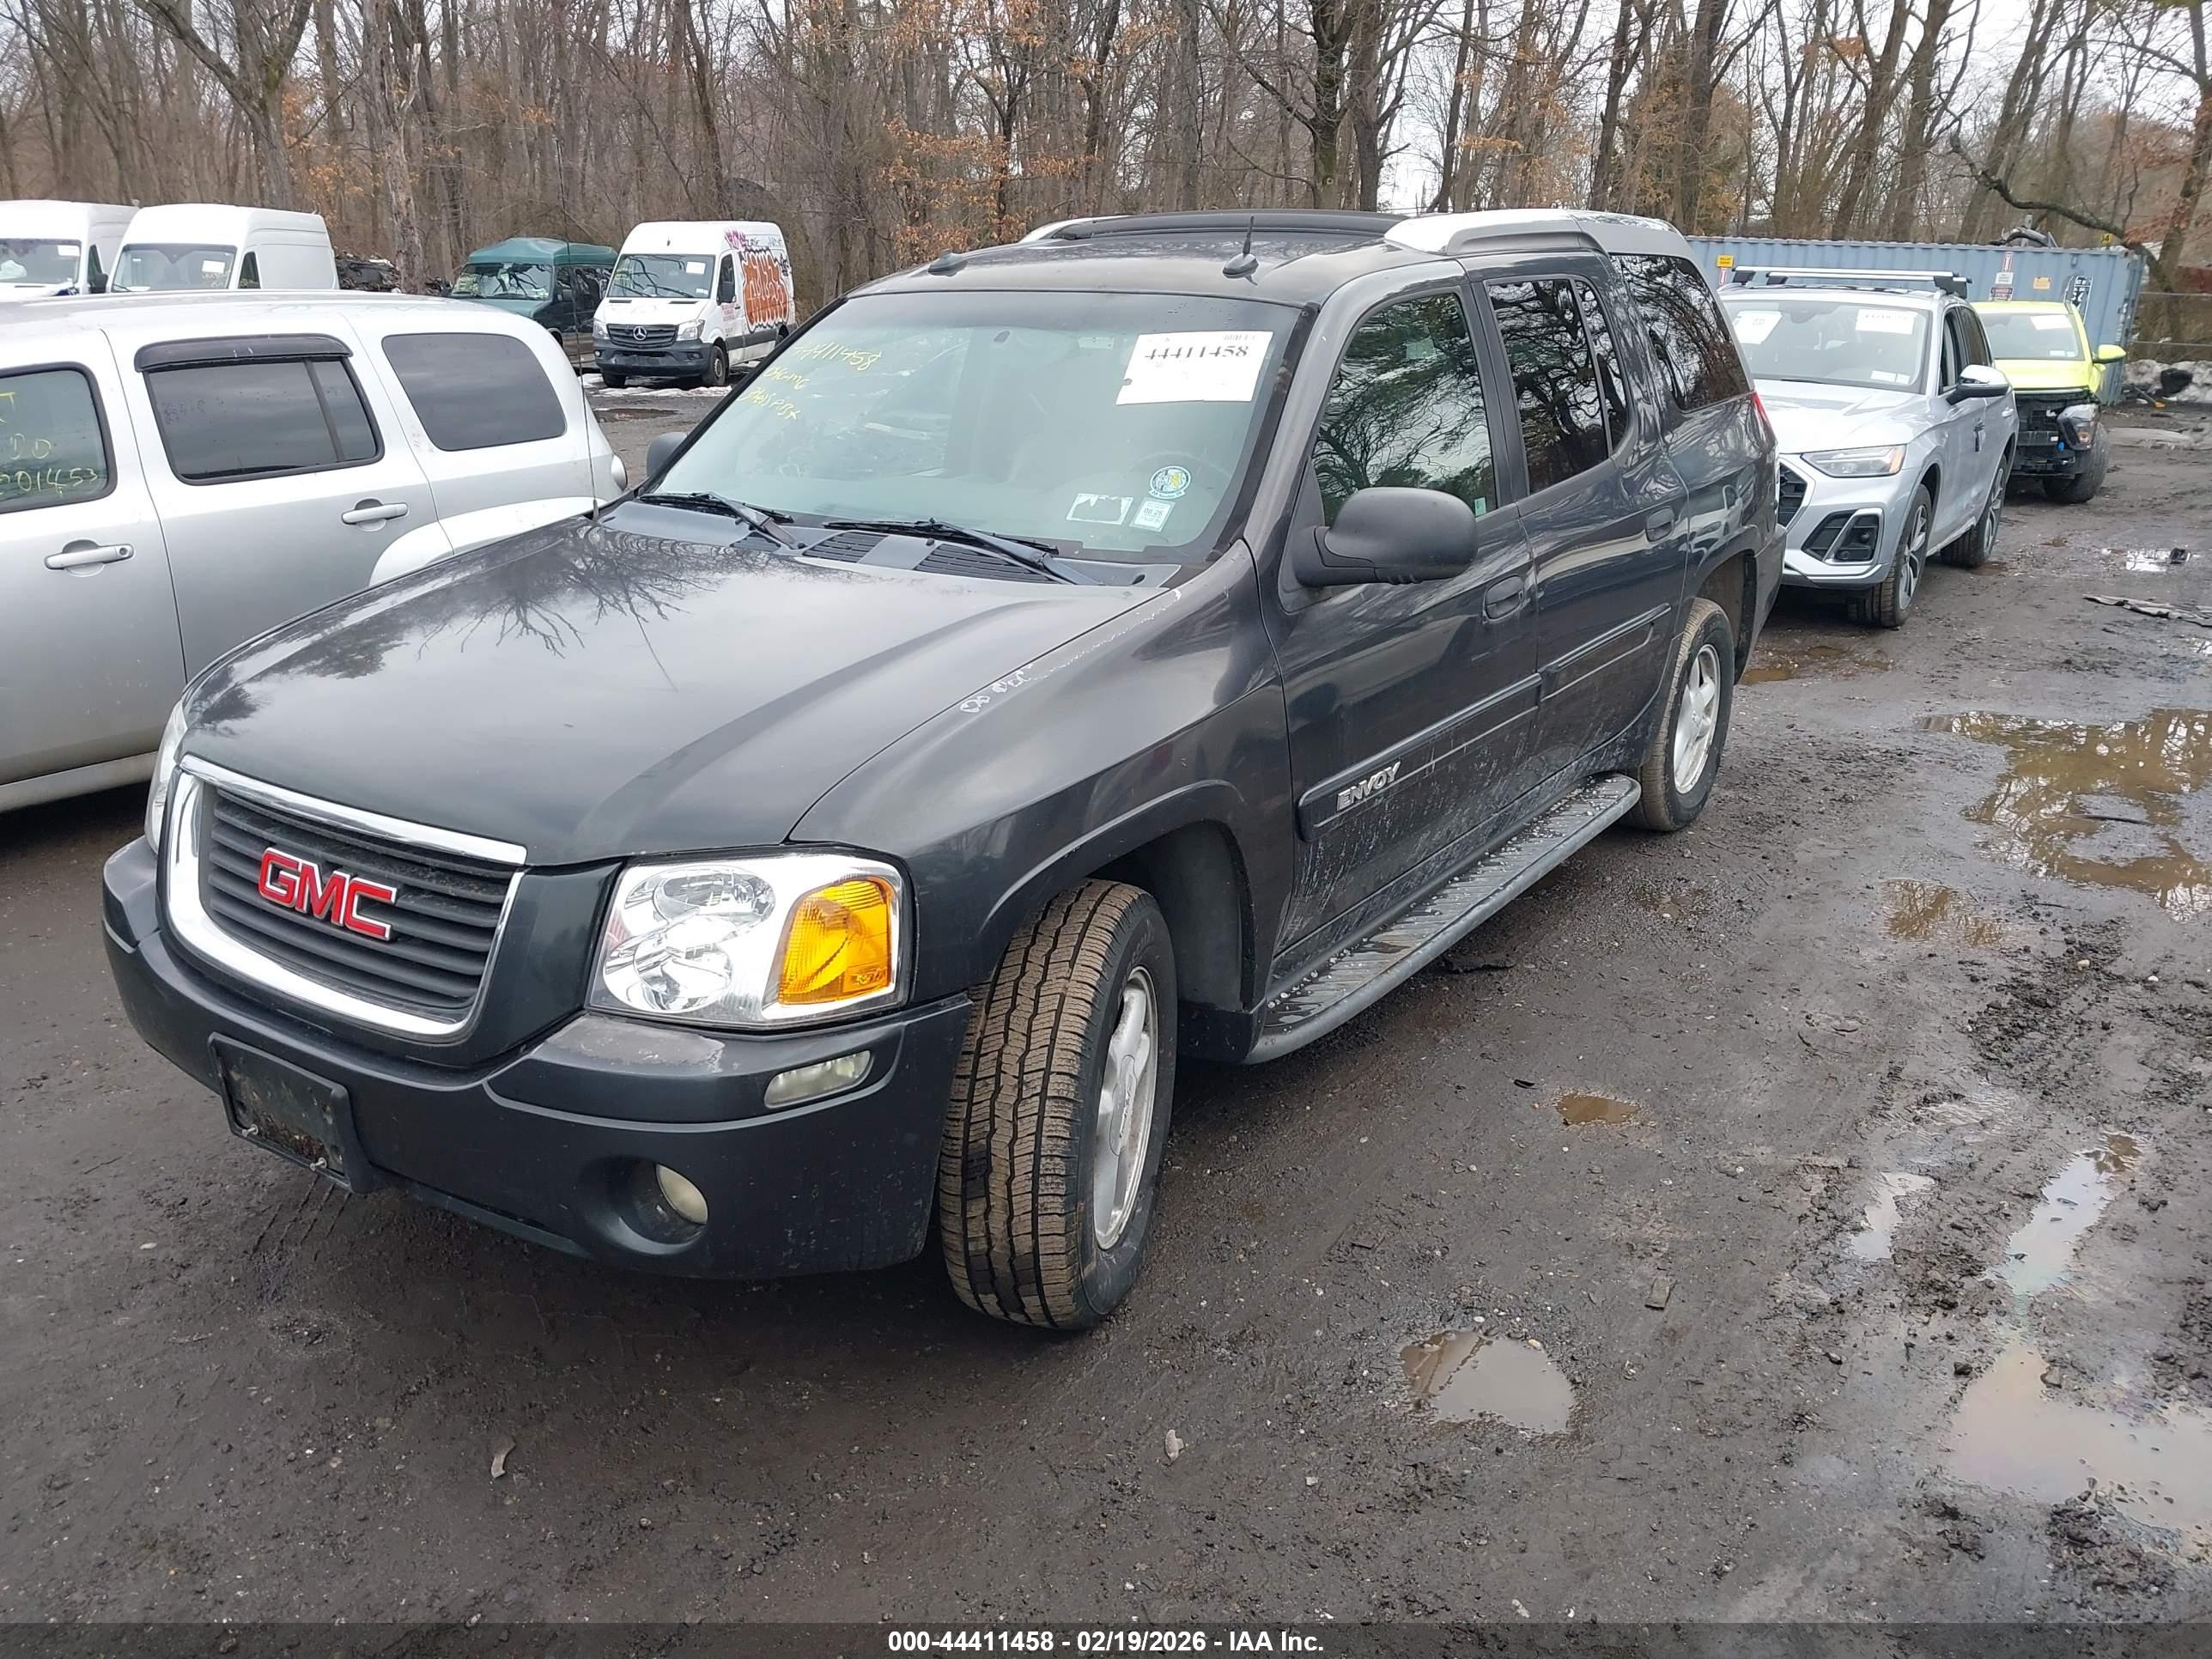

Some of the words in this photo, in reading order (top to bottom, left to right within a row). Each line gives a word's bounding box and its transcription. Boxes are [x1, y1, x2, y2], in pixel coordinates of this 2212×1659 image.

[1144, 345, 1249, 361] 44411458
[1336, 761, 1401, 812] ENVOY
[258, 847, 398, 941] GMC
